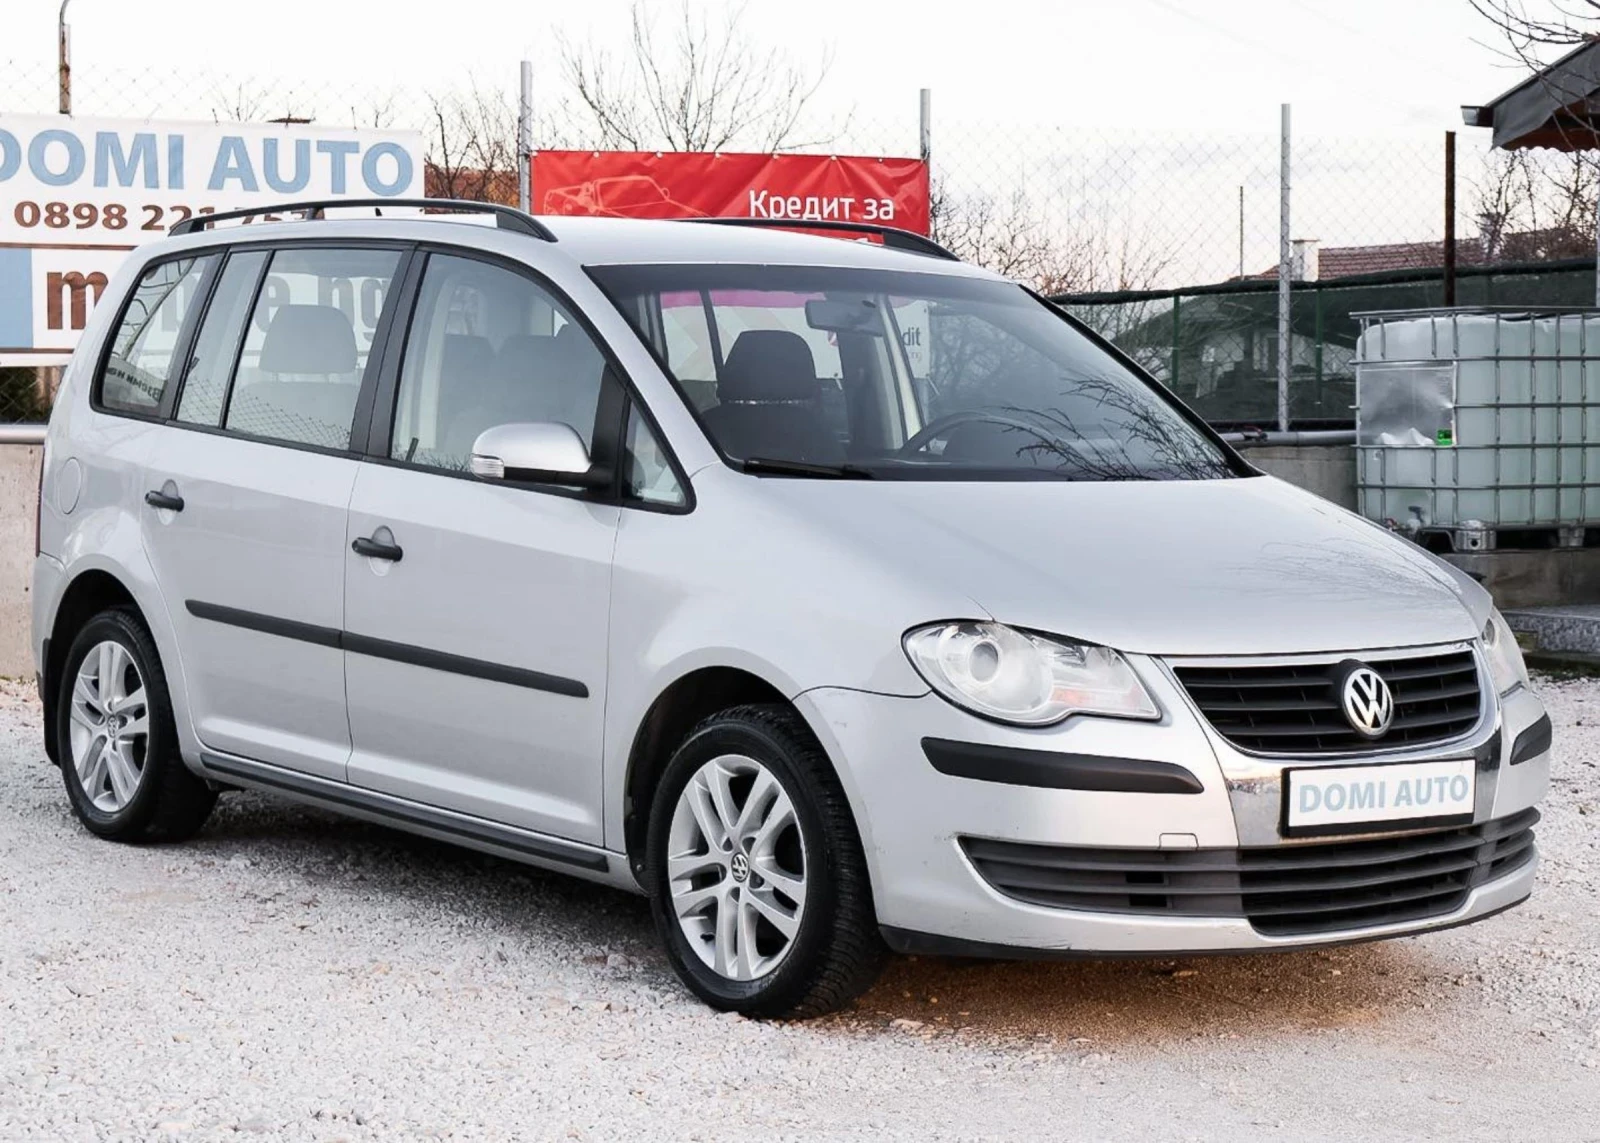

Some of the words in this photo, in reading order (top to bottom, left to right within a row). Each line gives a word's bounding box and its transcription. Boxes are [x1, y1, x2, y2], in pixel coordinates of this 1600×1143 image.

[207, 136, 414, 197] AUTO
[14, 201, 128, 230] 0898
[749, 189, 855, 221] Кредит
[862, 198, 894, 220] за
[1299, 781, 1386, 813] DOMI
[1394, 774, 1469, 806] AUTO
